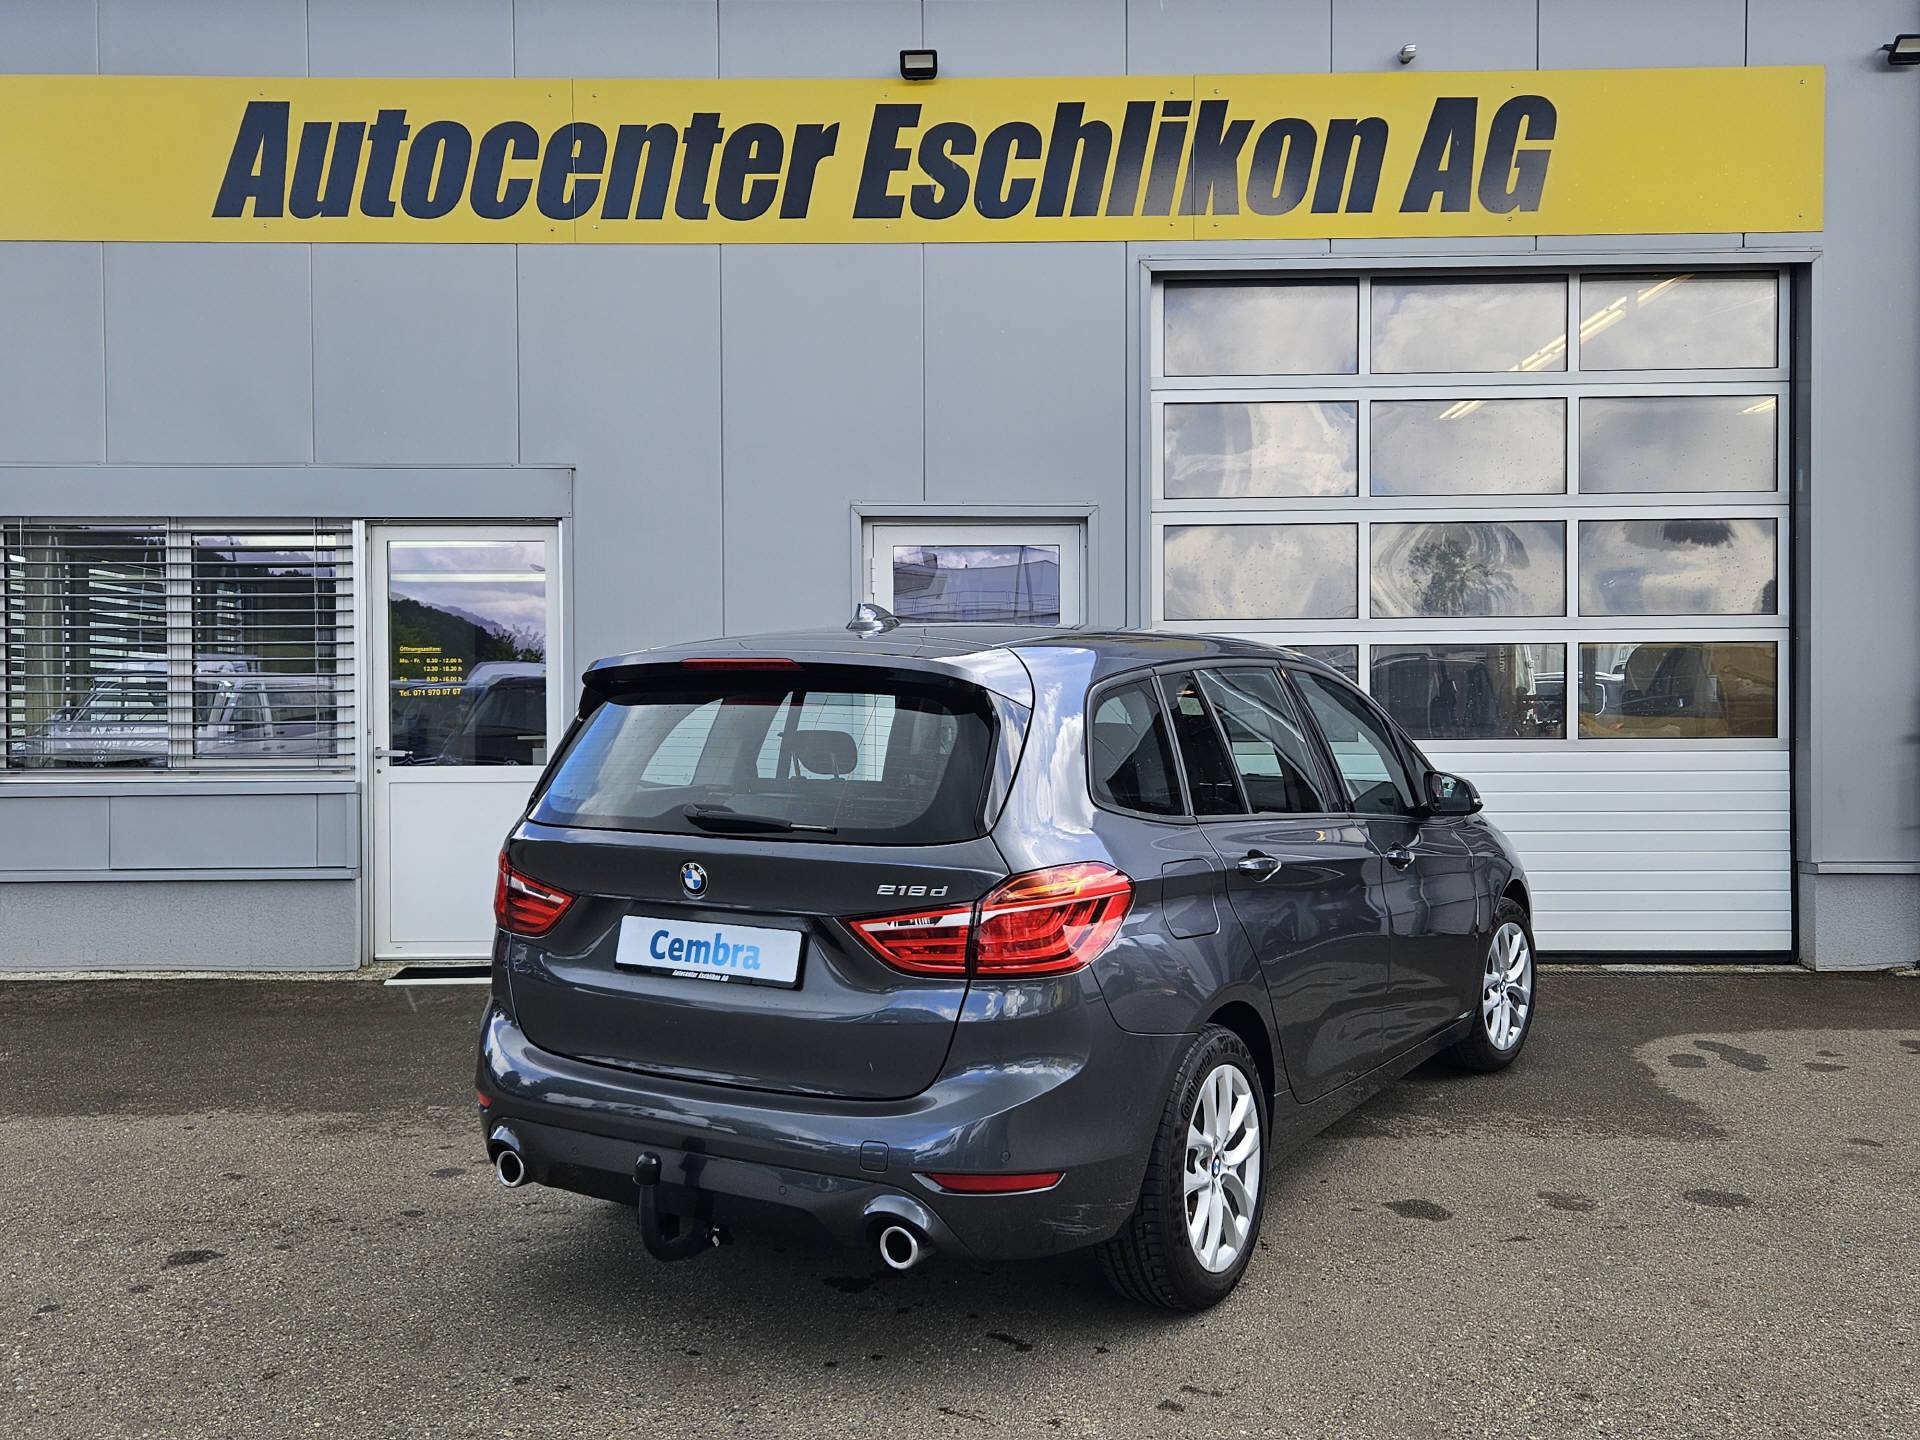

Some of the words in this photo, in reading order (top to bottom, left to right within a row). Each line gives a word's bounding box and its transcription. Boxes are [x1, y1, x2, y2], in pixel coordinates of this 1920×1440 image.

[211, 101, 840, 221] Autocenter
[852, 99, 1389, 220] Eschlikon
[1398, 94, 1558, 213] AG
[427, 688, 441, 696] 970
[650, 929, 761, 971] Cembra
